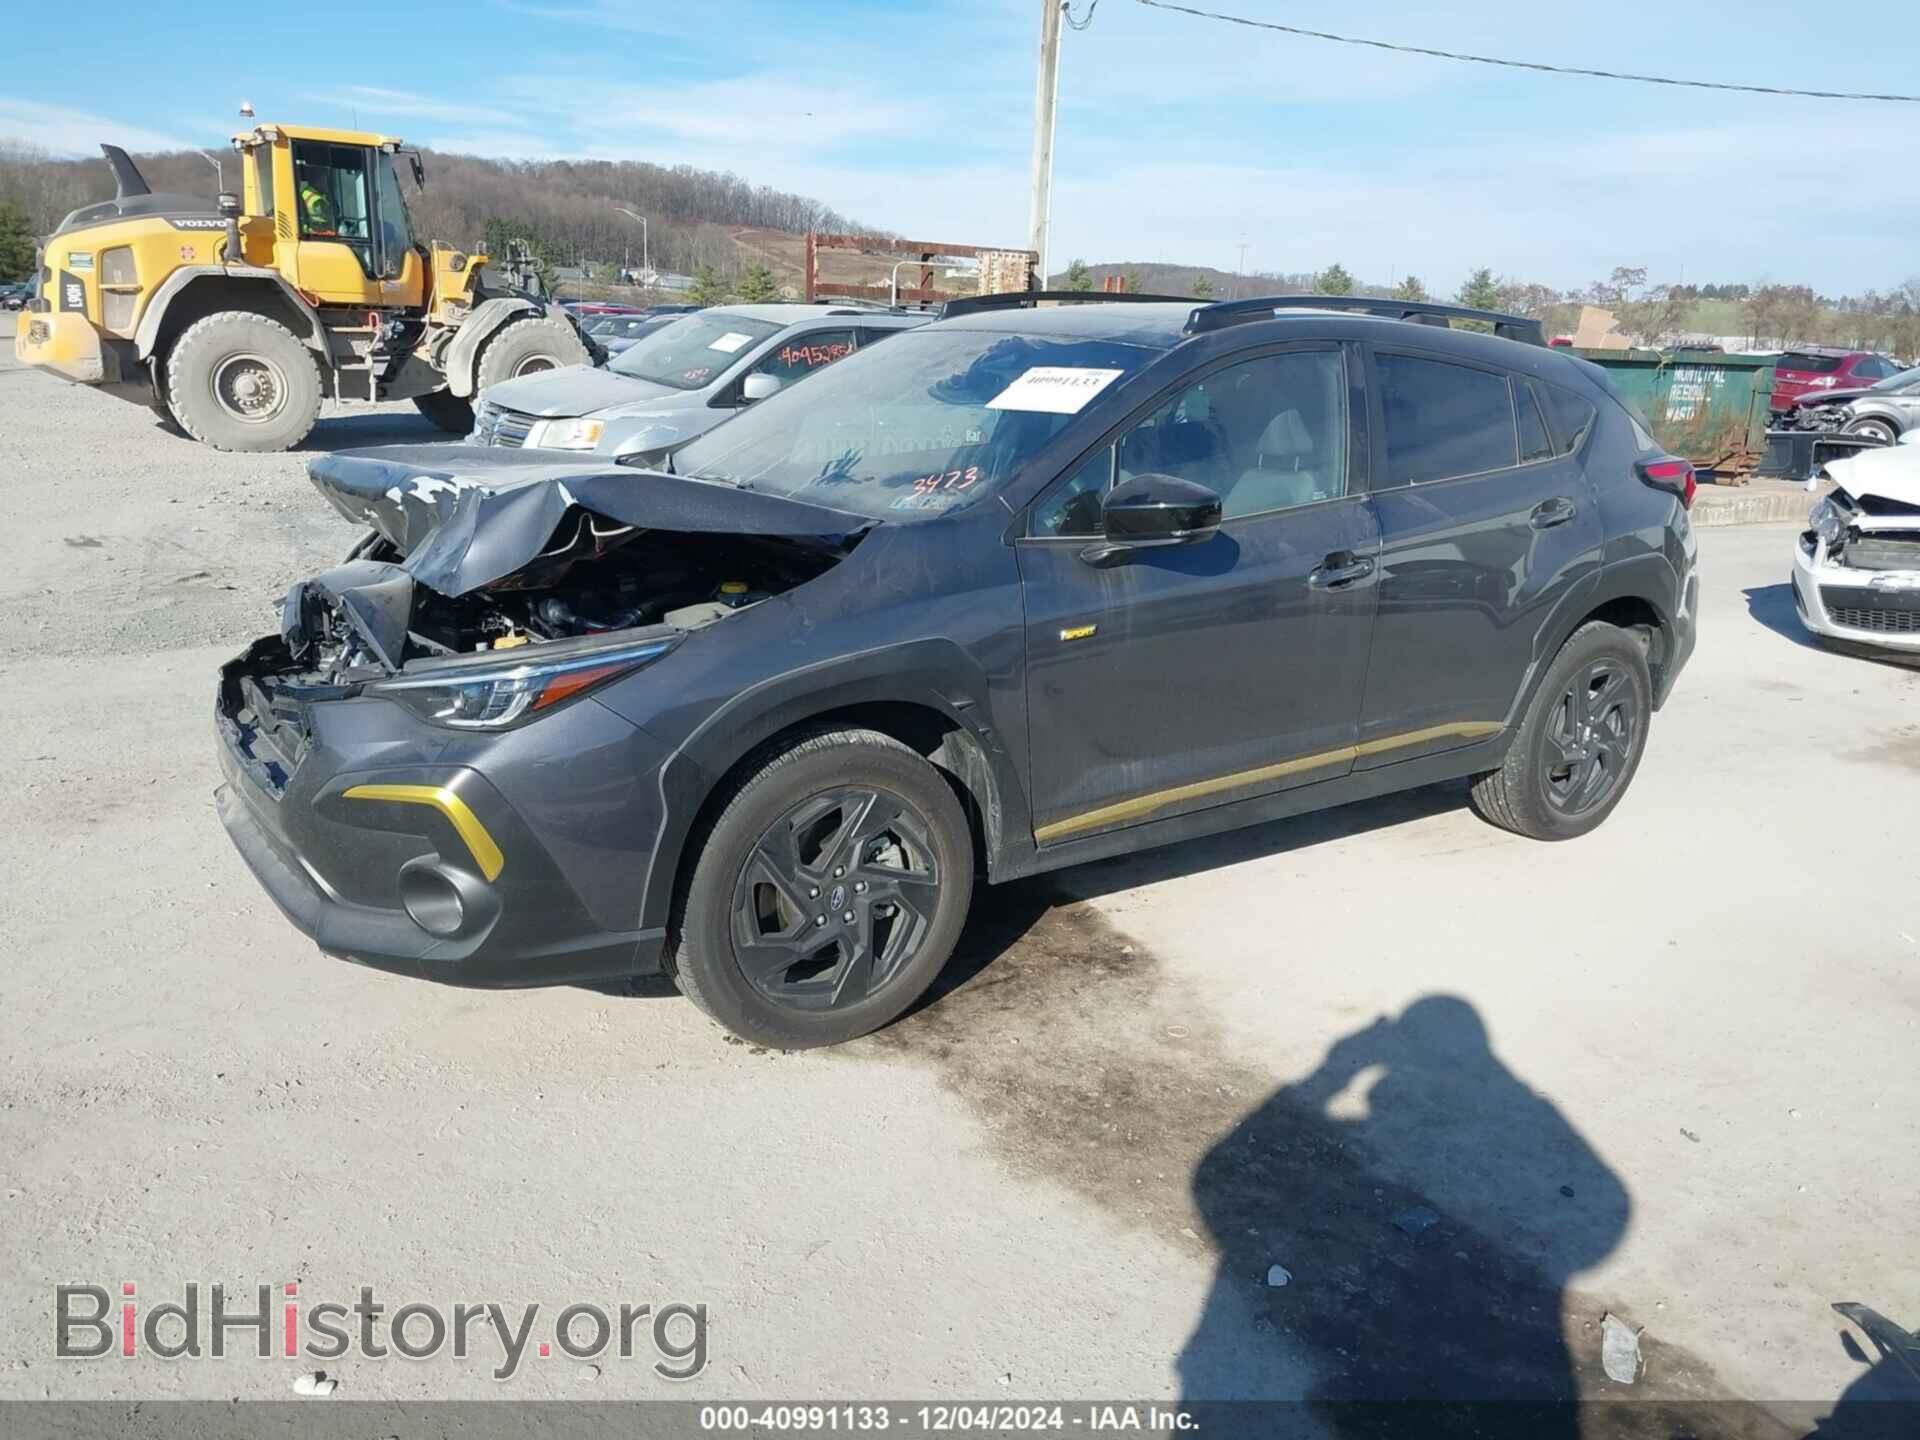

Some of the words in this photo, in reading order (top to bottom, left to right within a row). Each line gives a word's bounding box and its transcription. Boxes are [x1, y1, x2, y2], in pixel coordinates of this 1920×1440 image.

[175, 219, 227, 228] VOLVO
[66, 283, 83, 308] L90H
[1674, 366, 1725, 384] MUNICIPAL
[1664, 406, 1696, 422] WAST
[911, 466, 978, 499] 3473
